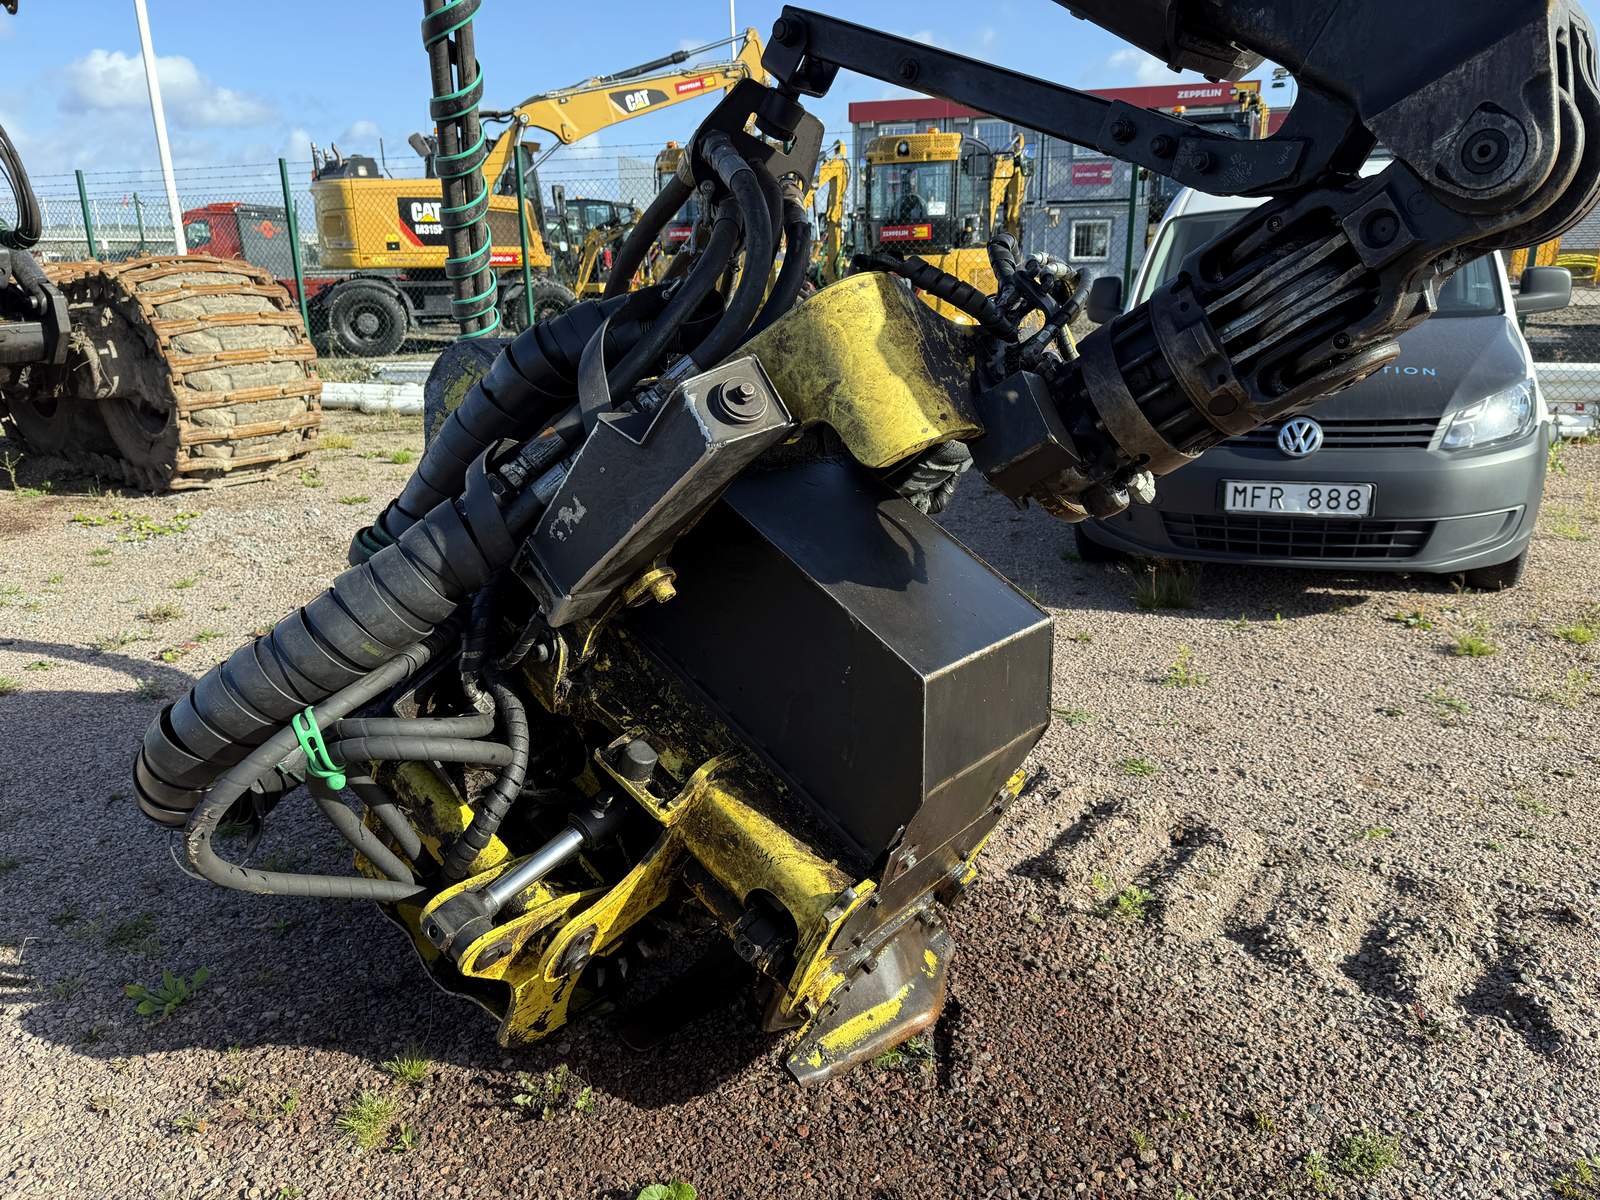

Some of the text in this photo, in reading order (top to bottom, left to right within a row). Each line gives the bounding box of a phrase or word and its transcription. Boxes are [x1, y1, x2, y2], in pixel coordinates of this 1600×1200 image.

[625, 89, 650, 112] CAT
[1176, 89, 1222, 99] ZEPPELIN
[411, 202, 441, 223] CAT
[1382, 366, 1437, 377] TION
[1232, 485, 1361, 511] MFR 888
